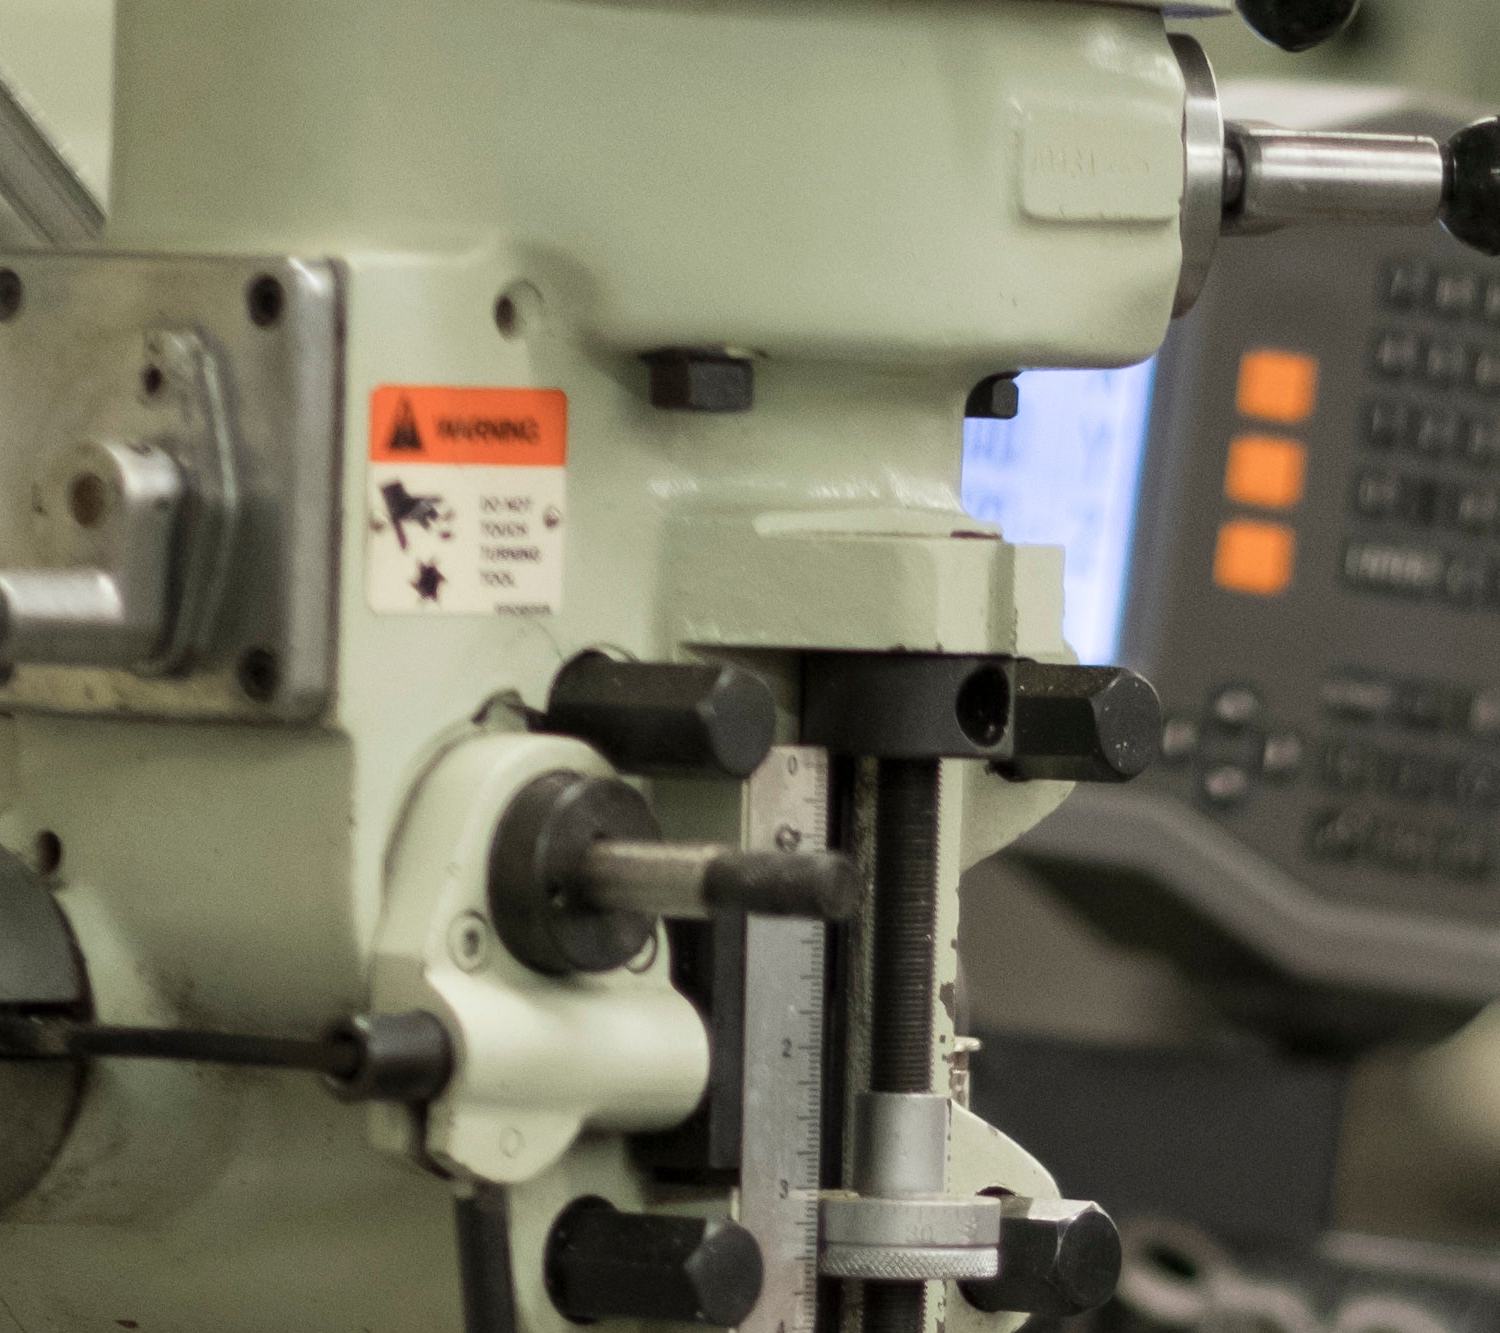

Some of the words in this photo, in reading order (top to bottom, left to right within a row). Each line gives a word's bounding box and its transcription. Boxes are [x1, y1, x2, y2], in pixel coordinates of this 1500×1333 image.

[436, 415, 540, 443] WARNING
[481, 495, 501, 513] DO
[503, 495, 533, 513] NOT
[480, 520, 528, 537] TOUCH
[480, 544, 541, 562] TURNING
[480, 570, 515, 587] TOOL
[787, 754, 798, 776] 0
[782, 1037, 793, 1059] 2
[778, 1178, 790, 1201] 3
